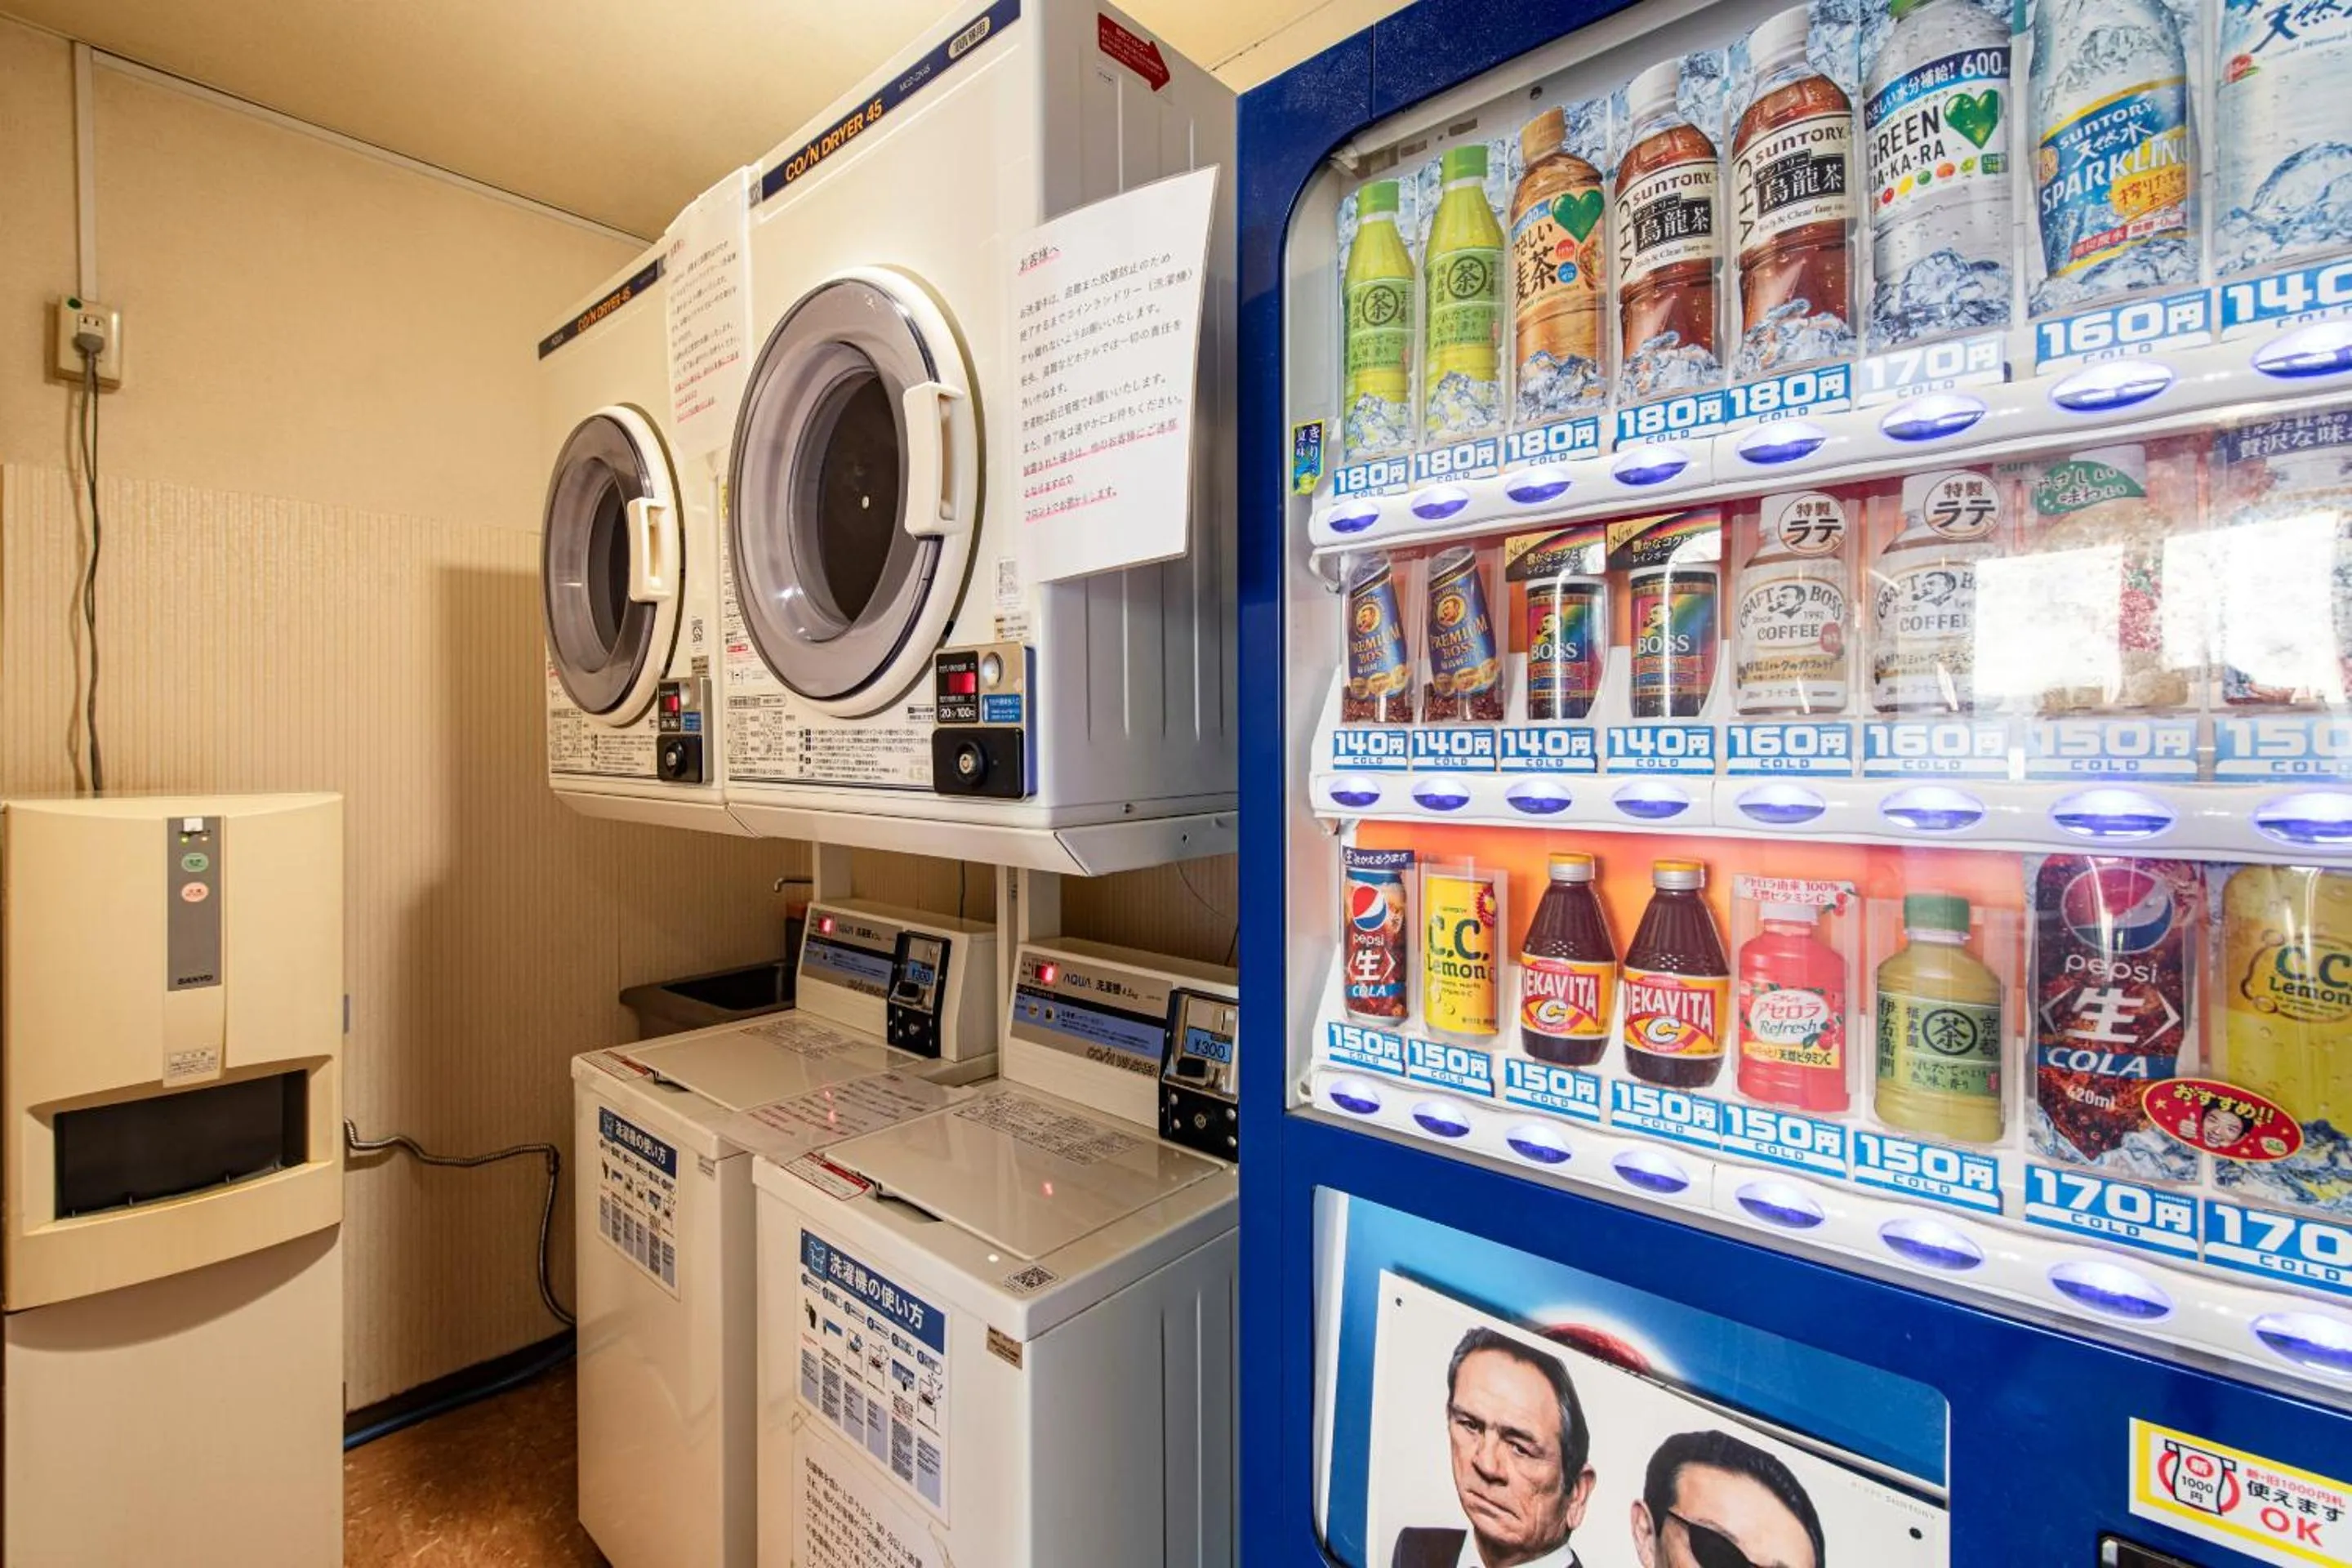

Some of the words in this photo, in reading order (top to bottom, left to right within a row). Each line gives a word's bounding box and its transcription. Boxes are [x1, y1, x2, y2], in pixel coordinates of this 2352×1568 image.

[822, 113, 863, 156] DRYER
[866, 99, 883, 123] 45
[2059, 99, 2154, 150] SUNTORY
[1757, 127, 1846, 164] SUNTORY
[1633, 172, 1712, 206] SUNTORY
[1765, 163, 1842, 208] 烏龍茶
[1639, 206, 1709, 250] 烏龍茶
[2042, 299, 2200, 357] 160円
[1864, 342, 1998, 390] 170円
[1731, 374, 1844, 416] 180円
[1897, 380, 1954, 399] COLD
[1621, 398, 1721, 437] 180円
[1759, 406, 1809, 424] COLD
[1506, 424, 1595, 460] 180円
[1646, 430, 1690, 444] COLD
[1417, 444, 1494, 476] 180円
[1530, 453, 1567, 466] COLD
[1336, 462, 1405, 492] 180円
[1437, 471, 1470, 483] COLD
[1944, 481, 1983, 498] 特製
[1352, 488, 1384, 499] COLD
[1796, 501, 1830, 518] 特製
[1934, 500, 1995, 528] ラテ
[1787, 519, 1842, 545] ラテ
[1740, 587, 1775, 628] CRAFT
[1810, 586, 1843, 621] BOSS
[1637, 635, 1690, 655] BOSS
[1757, 624, 1820, 640] COFFEE
[1531, 642, 1578, 660] BOSS
[1338, 731, 1403, 755] 140円
[1414, 730, 1491, 755] 140円
[1503, 728, 1588, 755] 140円
[1611, 728, 1709, 755] 140円
[1730, 726, 1846, 755] 160円
[1869, 724, 2007, 756] 160円
[2033, 721, 2190, 756] 150円
[1352, 757, 1383, 765] COLD
[1434, 757, 1468, 766] COLD
[1526, 758, 1563, 767] COLD
[1636, 758, 1679, 768] COLD
[1760, 759, 1810, 768] COLD
[1903, 760, 1962, 771] COLD
[2071, 760, 2140, 772] COLD
[1352, 933, 1385, 947] pepsi
[1355, 950, 1383, 981] 生
[2065, 954, 2157, 982] pepsi
[1352, 985, 1388, 998] COLA
[1537, 998, 1568, 1023] C
[1757, 1001, 1820, 1019] アセロラ
[2066, 987, 2146, 1044] 生
[1646, 1016, 1682, 1044] C
[1759, 1019, 1817, 1036] Refresh
[1933, 1016, 1970, 1049] 茶
[1194, 1037, 1226, 1059] ¥300
[1331, 1026, 1401, 1060] 150円
[1350, 1051, 1379, 1064] COLD
[1411, 1040, 1487, 1079] 150円
[2047, 1049, 2149, 1078] COLA
[1431, 1070, 1464, 1085] COLD
[1509, 1061, 1596, 1102] 150円
[1530, 1093, 1568, 1107] COLD
[1615, 1084, 1717, 1129] 150円
[2067, 1084, 2117, 1111] 420ml
[2173, 1083, 2274, 1125] おすすめ!!
[1642, 1117, 1684, 1134] COLD
[1727, 1107, 1842, 1156] 150円
[614, 1116, 667, 1166] 洗濯機の使い方
[1756, 1143, 1804, 1161] COLD
[1860, 1135, 1994, 1191] 150円
[1894, 1174, 1951, 1195] COLD
[2034, 1169, 2192, 1233] 170円
[2071, 1213, 2140, 1237] COLD
[2260, 1254, 2341, 1281] COLD
[828, 1250, 924, 1330] 洗濯機の使い方
[2181, 1475, 2214, 1494] 1000
[2189, 1490, 2204, 1504] 円
[2247, 1480, 2345, 1523] 使えます
[2260, 1507, 2324, 1548] OK
